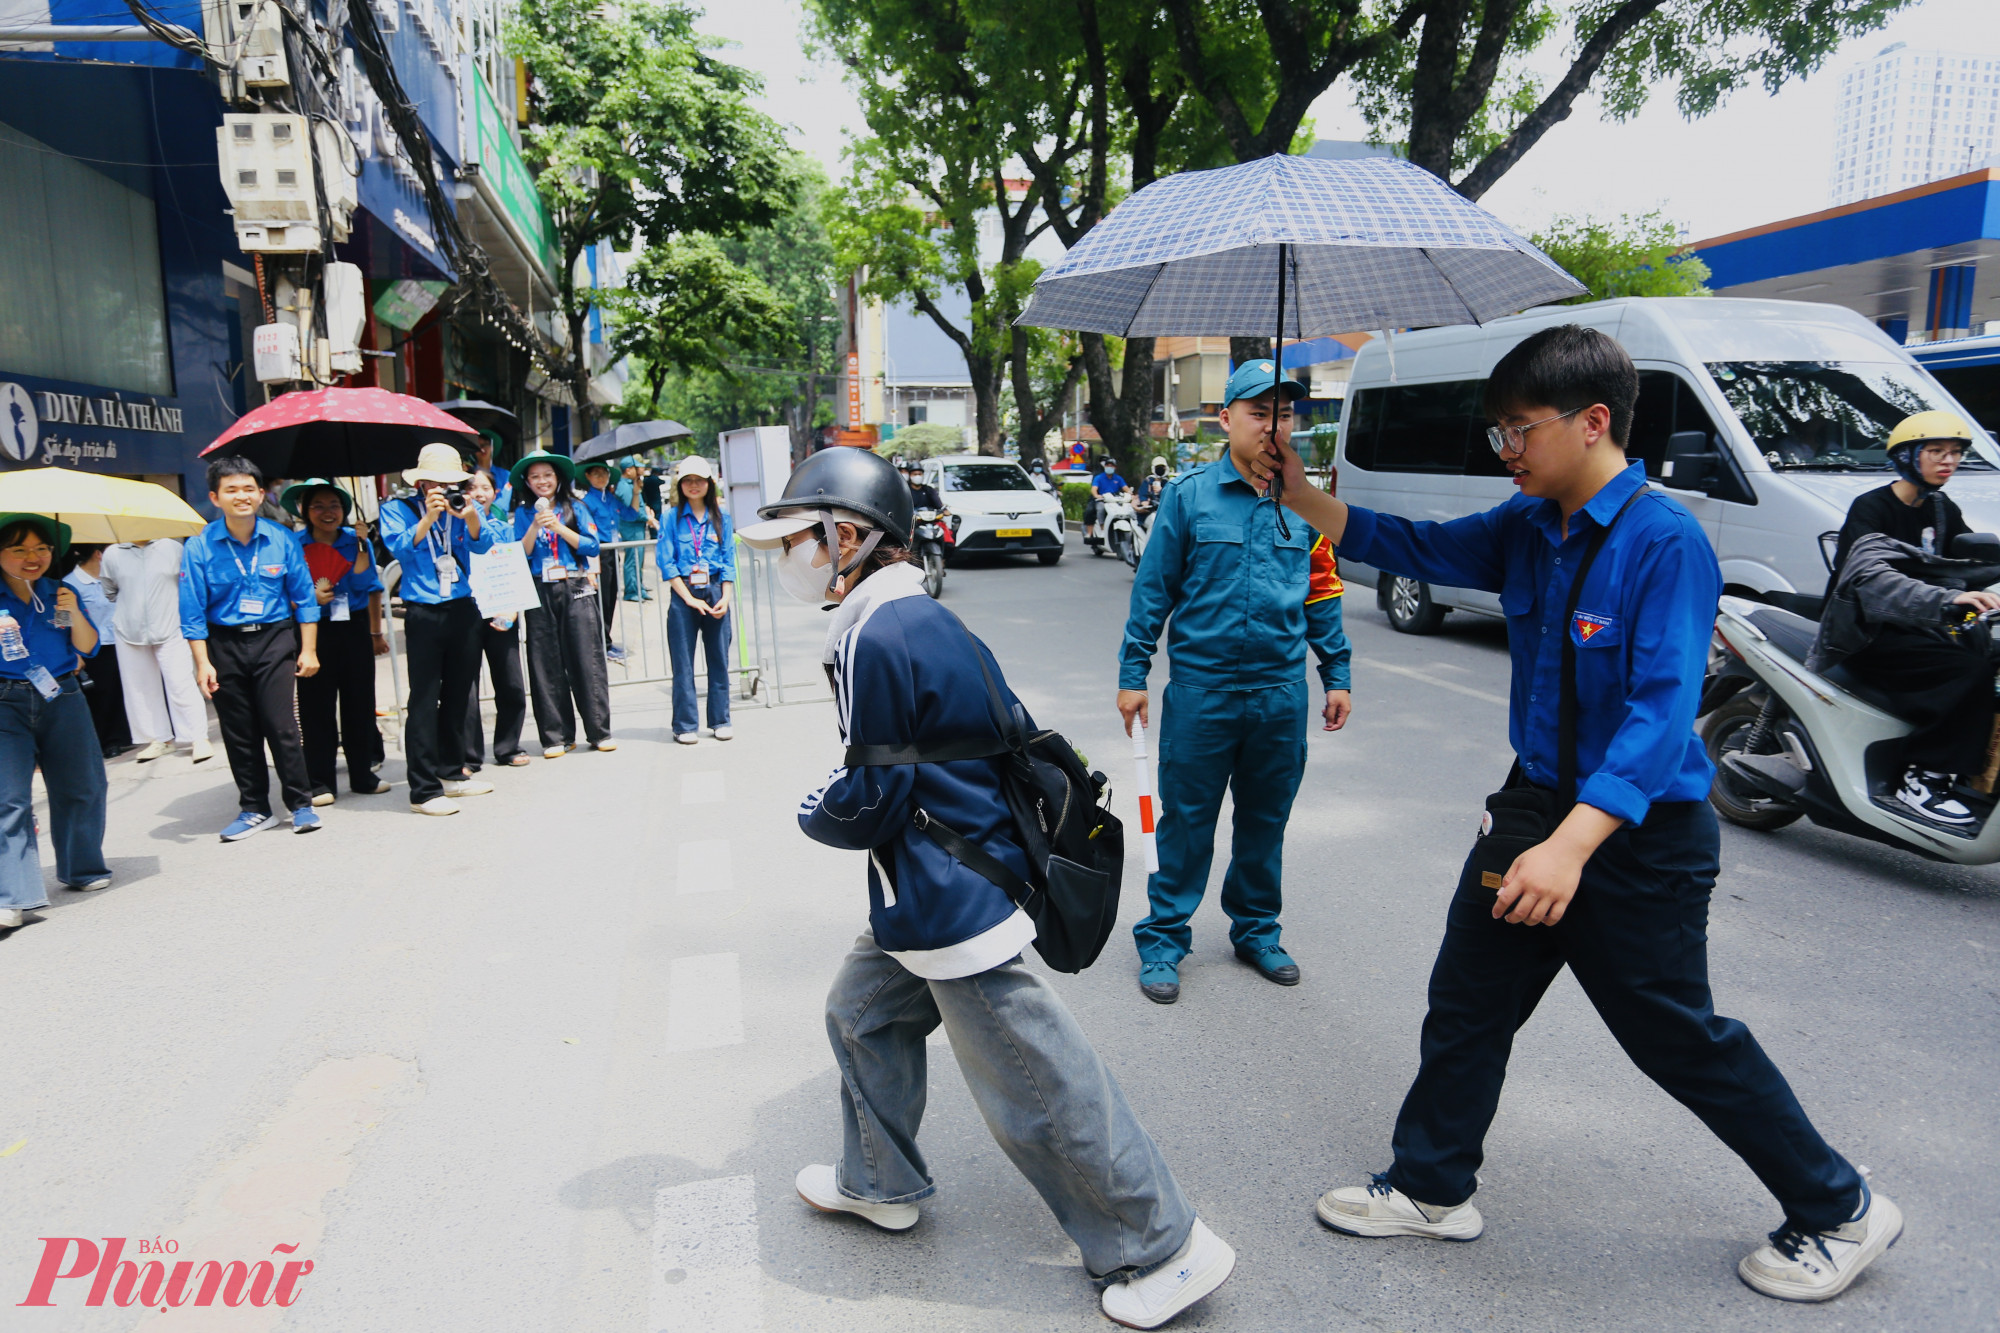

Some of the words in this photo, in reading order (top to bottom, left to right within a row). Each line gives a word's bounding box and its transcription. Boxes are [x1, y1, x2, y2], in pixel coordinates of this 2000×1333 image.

[43, 391, 98, 425] DIVA
[100, 392, 130, 428] HÀ
[127, 397, 184, 433] THÀNH
